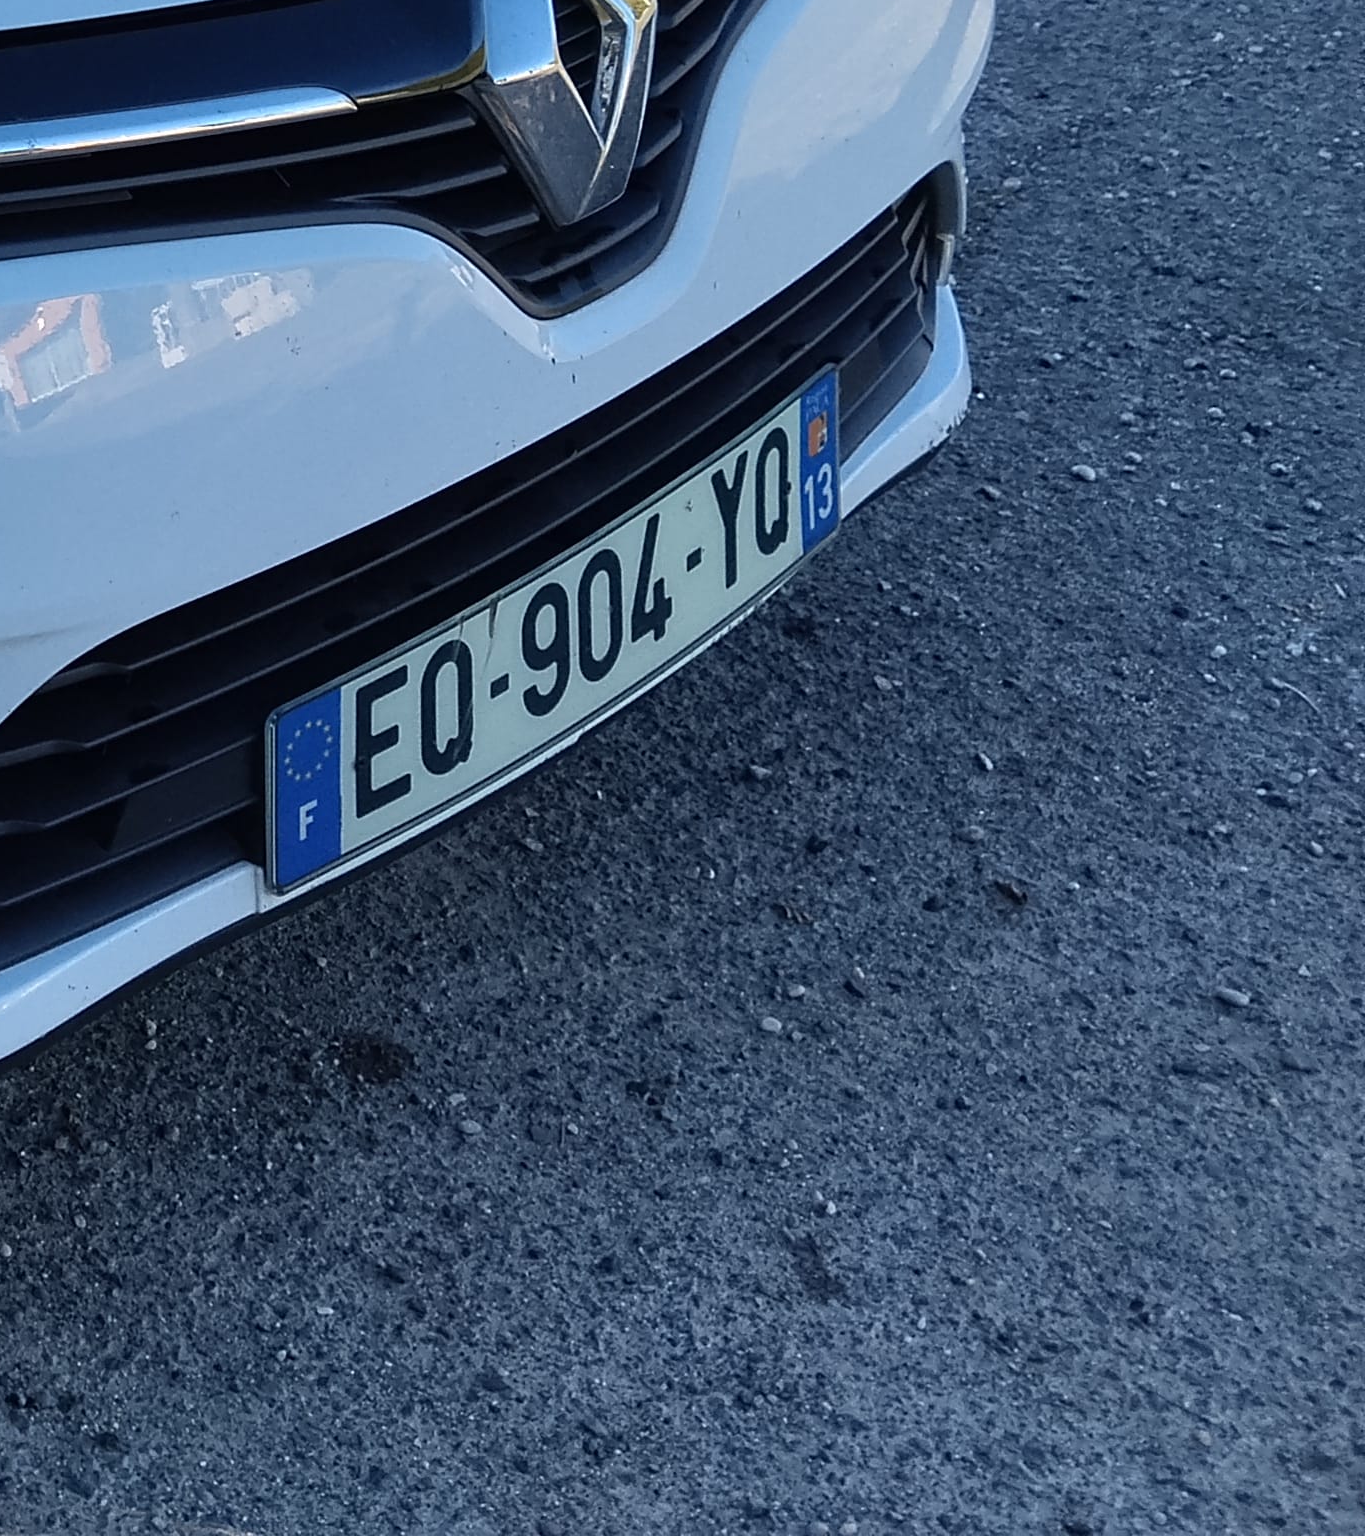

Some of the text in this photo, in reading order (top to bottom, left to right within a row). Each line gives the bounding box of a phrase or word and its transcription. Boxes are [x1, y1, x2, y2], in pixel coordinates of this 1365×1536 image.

[804, 462, 833, 530] 13
[355, 427, 789, 819] EQ-904-YQ
[299, 799, 318, 841] F
